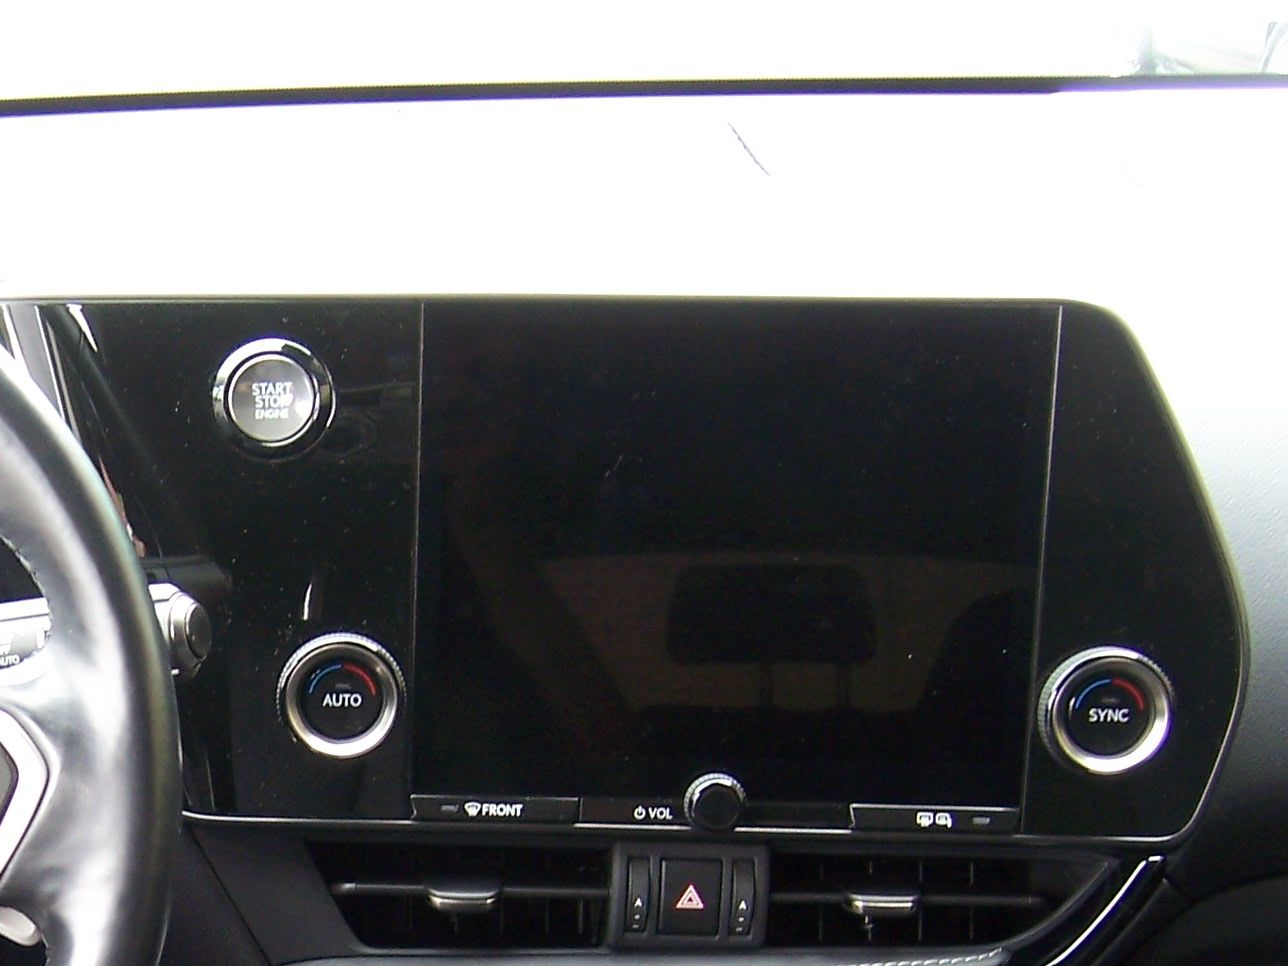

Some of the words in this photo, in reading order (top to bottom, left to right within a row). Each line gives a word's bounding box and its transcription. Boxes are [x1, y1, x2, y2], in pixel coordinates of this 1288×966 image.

[252, 382, 293, 396] START
[255, 394, 293, 408] STOP
[322, 693, 362, 708] AUTO
[1088, 707, 1130, 722] SYNC
[482, 803, 523, 817] FRONT
[648, 806, 674, 820] VOL
